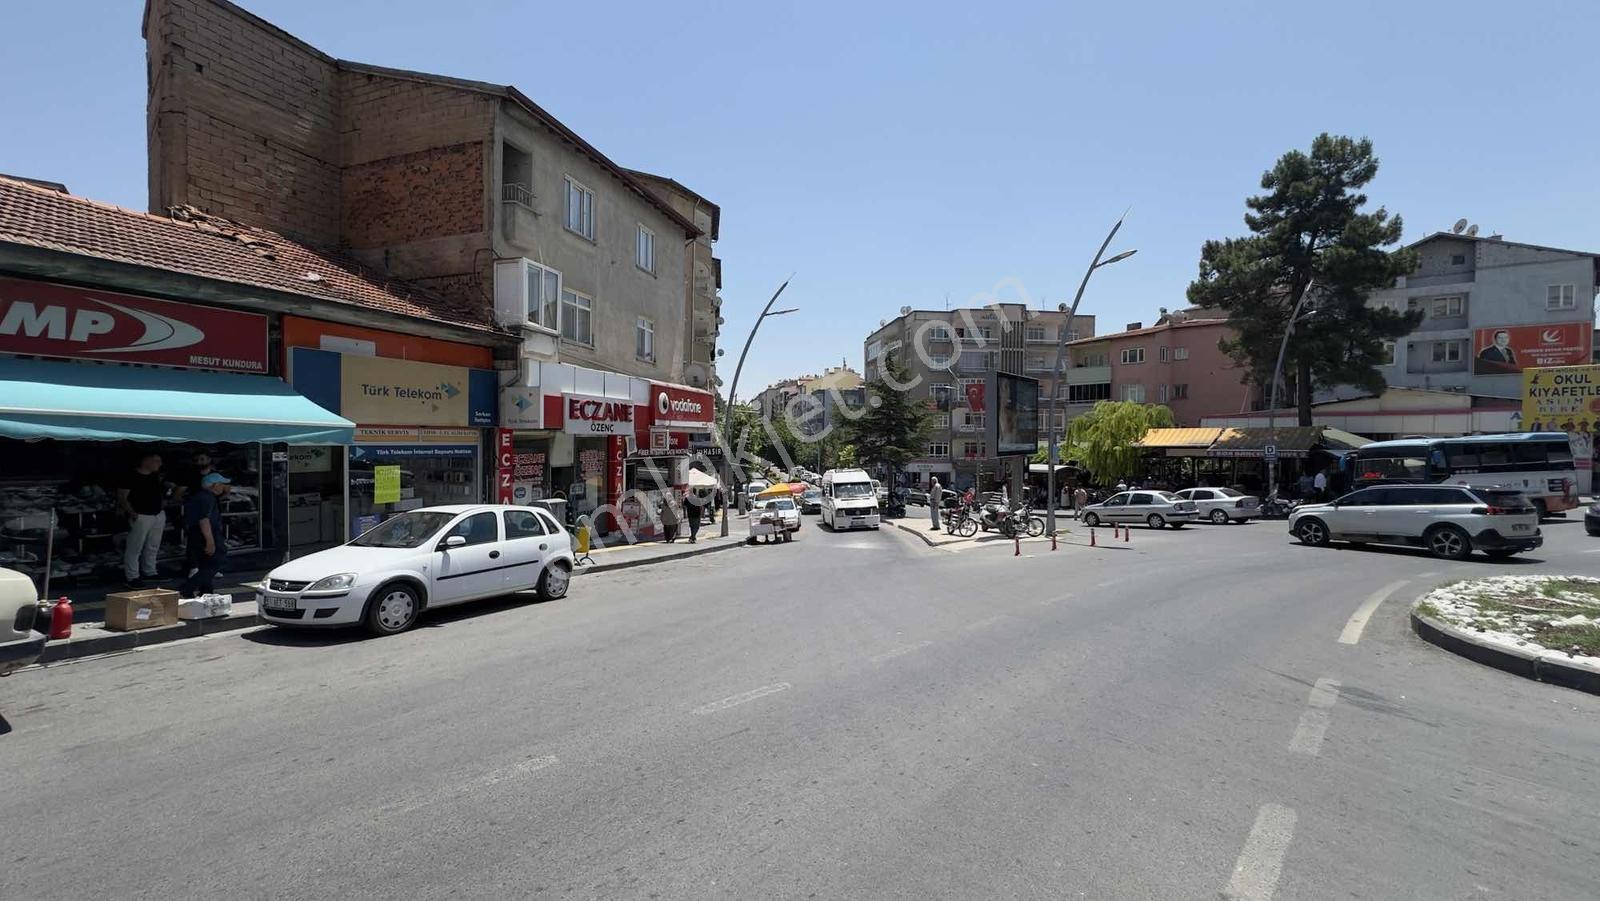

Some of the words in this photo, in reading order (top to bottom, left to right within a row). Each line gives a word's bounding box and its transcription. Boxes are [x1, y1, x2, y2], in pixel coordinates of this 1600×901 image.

[0, 301, 115, 342] MP
[190, 355, 220, 366] MESUT
[222, 359, 262, 370] KUNDURA
[1554, 374, 1592, 384] OKUL
[361, 384, 389, 397] Türk
[394, 387, 442, 400] Telekom
[569, 398, 633, 422] ECZANE
[670, 398, 702, 414] vodafone
